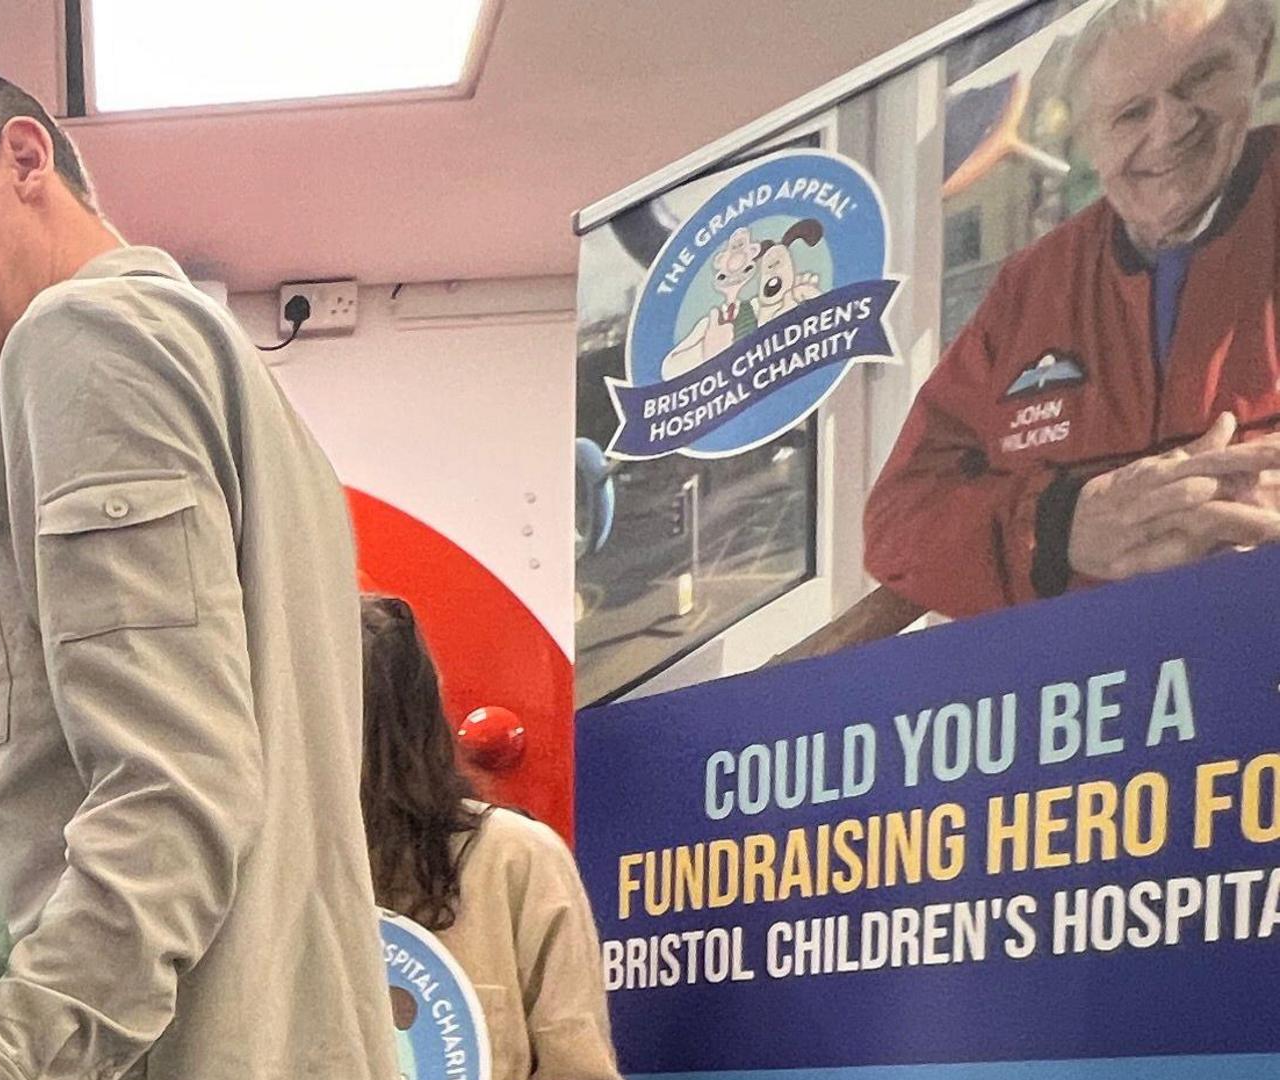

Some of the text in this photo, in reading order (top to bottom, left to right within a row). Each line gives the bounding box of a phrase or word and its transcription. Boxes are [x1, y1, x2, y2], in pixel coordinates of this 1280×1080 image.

[657, 177, 852, 296] THE GRAND APPEAL
[643, 296, 872, 420] BRISTOL CHILDREN'S
[649, 327, 860, 443] HOSPITAL CHARITY
[704, 656, 1196, 821] COULD YOU BE A
[618, 801, 966, 919] FUNDRAISING
[986, 770, 1169, 875] HERO
[602, 925, 754, 991] BRISTOL
[765, 893, 1037, 977] CHILDREN'S
